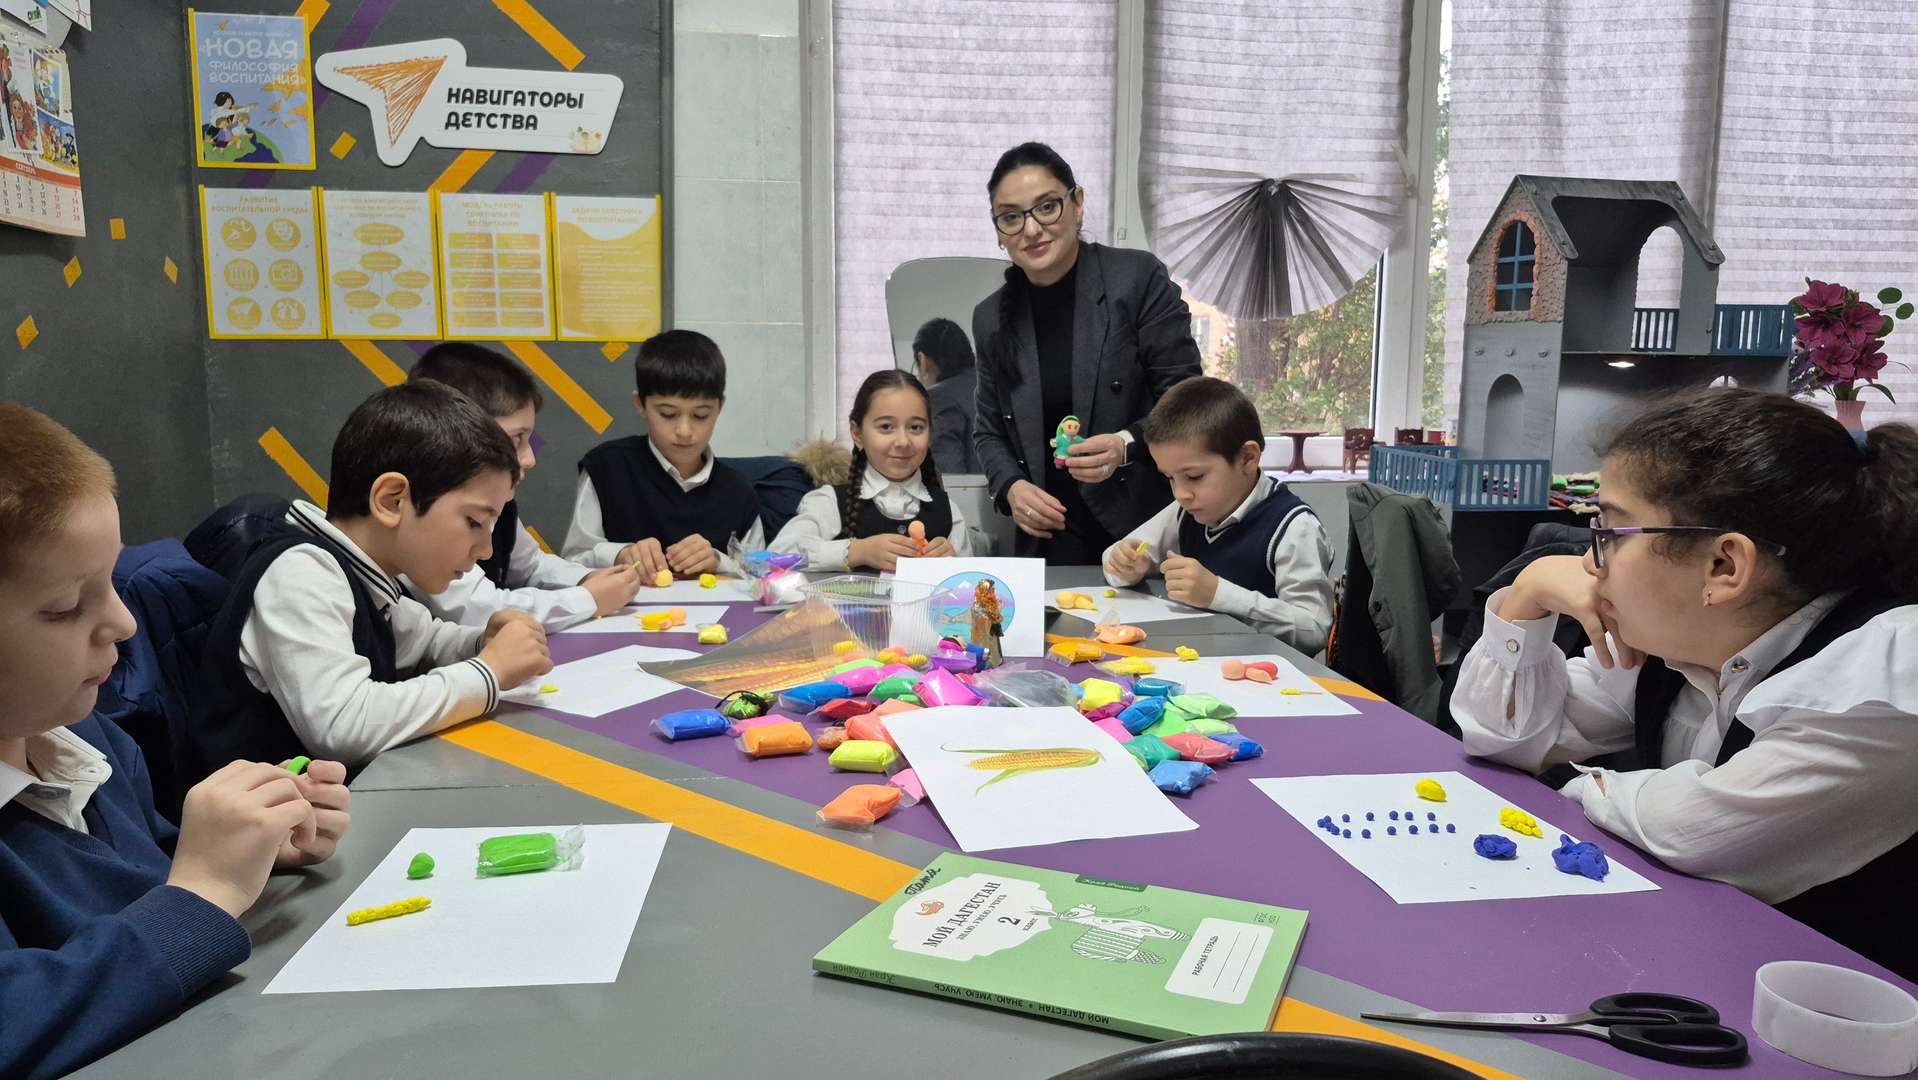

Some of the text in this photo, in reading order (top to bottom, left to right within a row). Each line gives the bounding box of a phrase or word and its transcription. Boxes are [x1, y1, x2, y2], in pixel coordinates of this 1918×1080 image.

[208, 60, 299, 73] ФИЛОСОФИЯ
[447, 87, 584, 109] НАВИГАТОРЫ
[445, 111, 538, 131] ДЕТСТВА
[922, 881, 1001, 948] МОЙ ДАГЕСТАН
[997, 916, 1021, 926] 2
[934, 983, 962, 996] УЧУСЬ
[1038, 1004, 1086, 1021] ДАГЕСТАН
[1087, 1013, 1110, 1025] МОЙ
